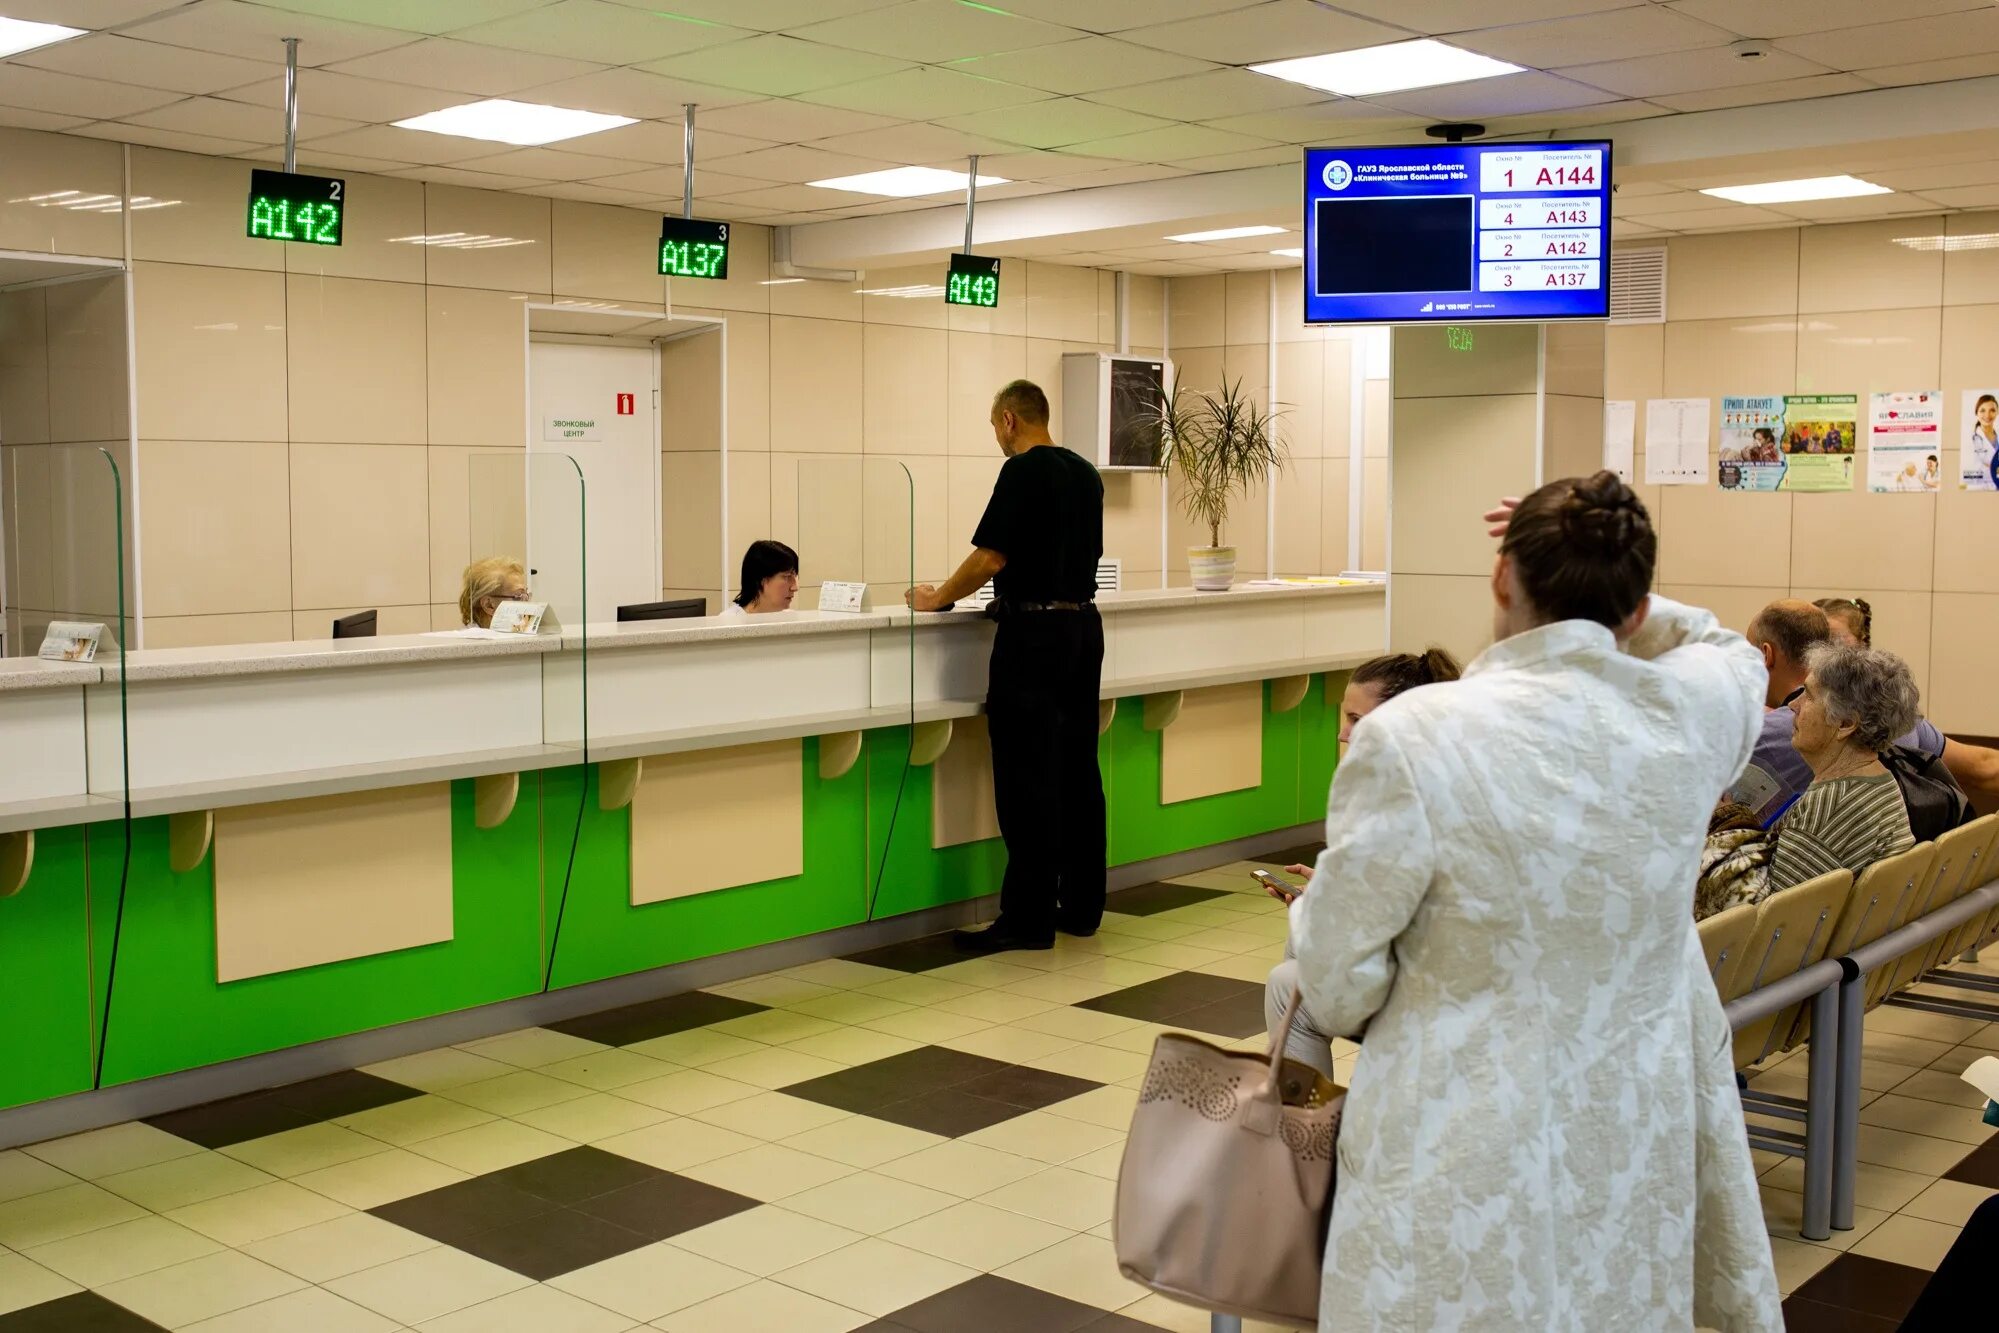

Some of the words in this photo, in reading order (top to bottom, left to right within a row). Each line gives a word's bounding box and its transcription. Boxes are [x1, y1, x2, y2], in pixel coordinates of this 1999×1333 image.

[1378, 164, 1430, 173] Ярославской
[1432, 163, 1464, 171] области
[1504, 169, 1513, 188] 1
[329, 182, 341, 200] 2
[1504, 213, 1514, 226] 4
[718, 225, 727, 241] 3
[1504, 244, 1513, 256] 2
[992, 260, 998, 274] 4
[1504, 274, 1512, 287] 3
[1747, 398, 1772, 409] АТАКУЕТ
[552, 420, 595, 428] ЗВОНКОВЫЙ
